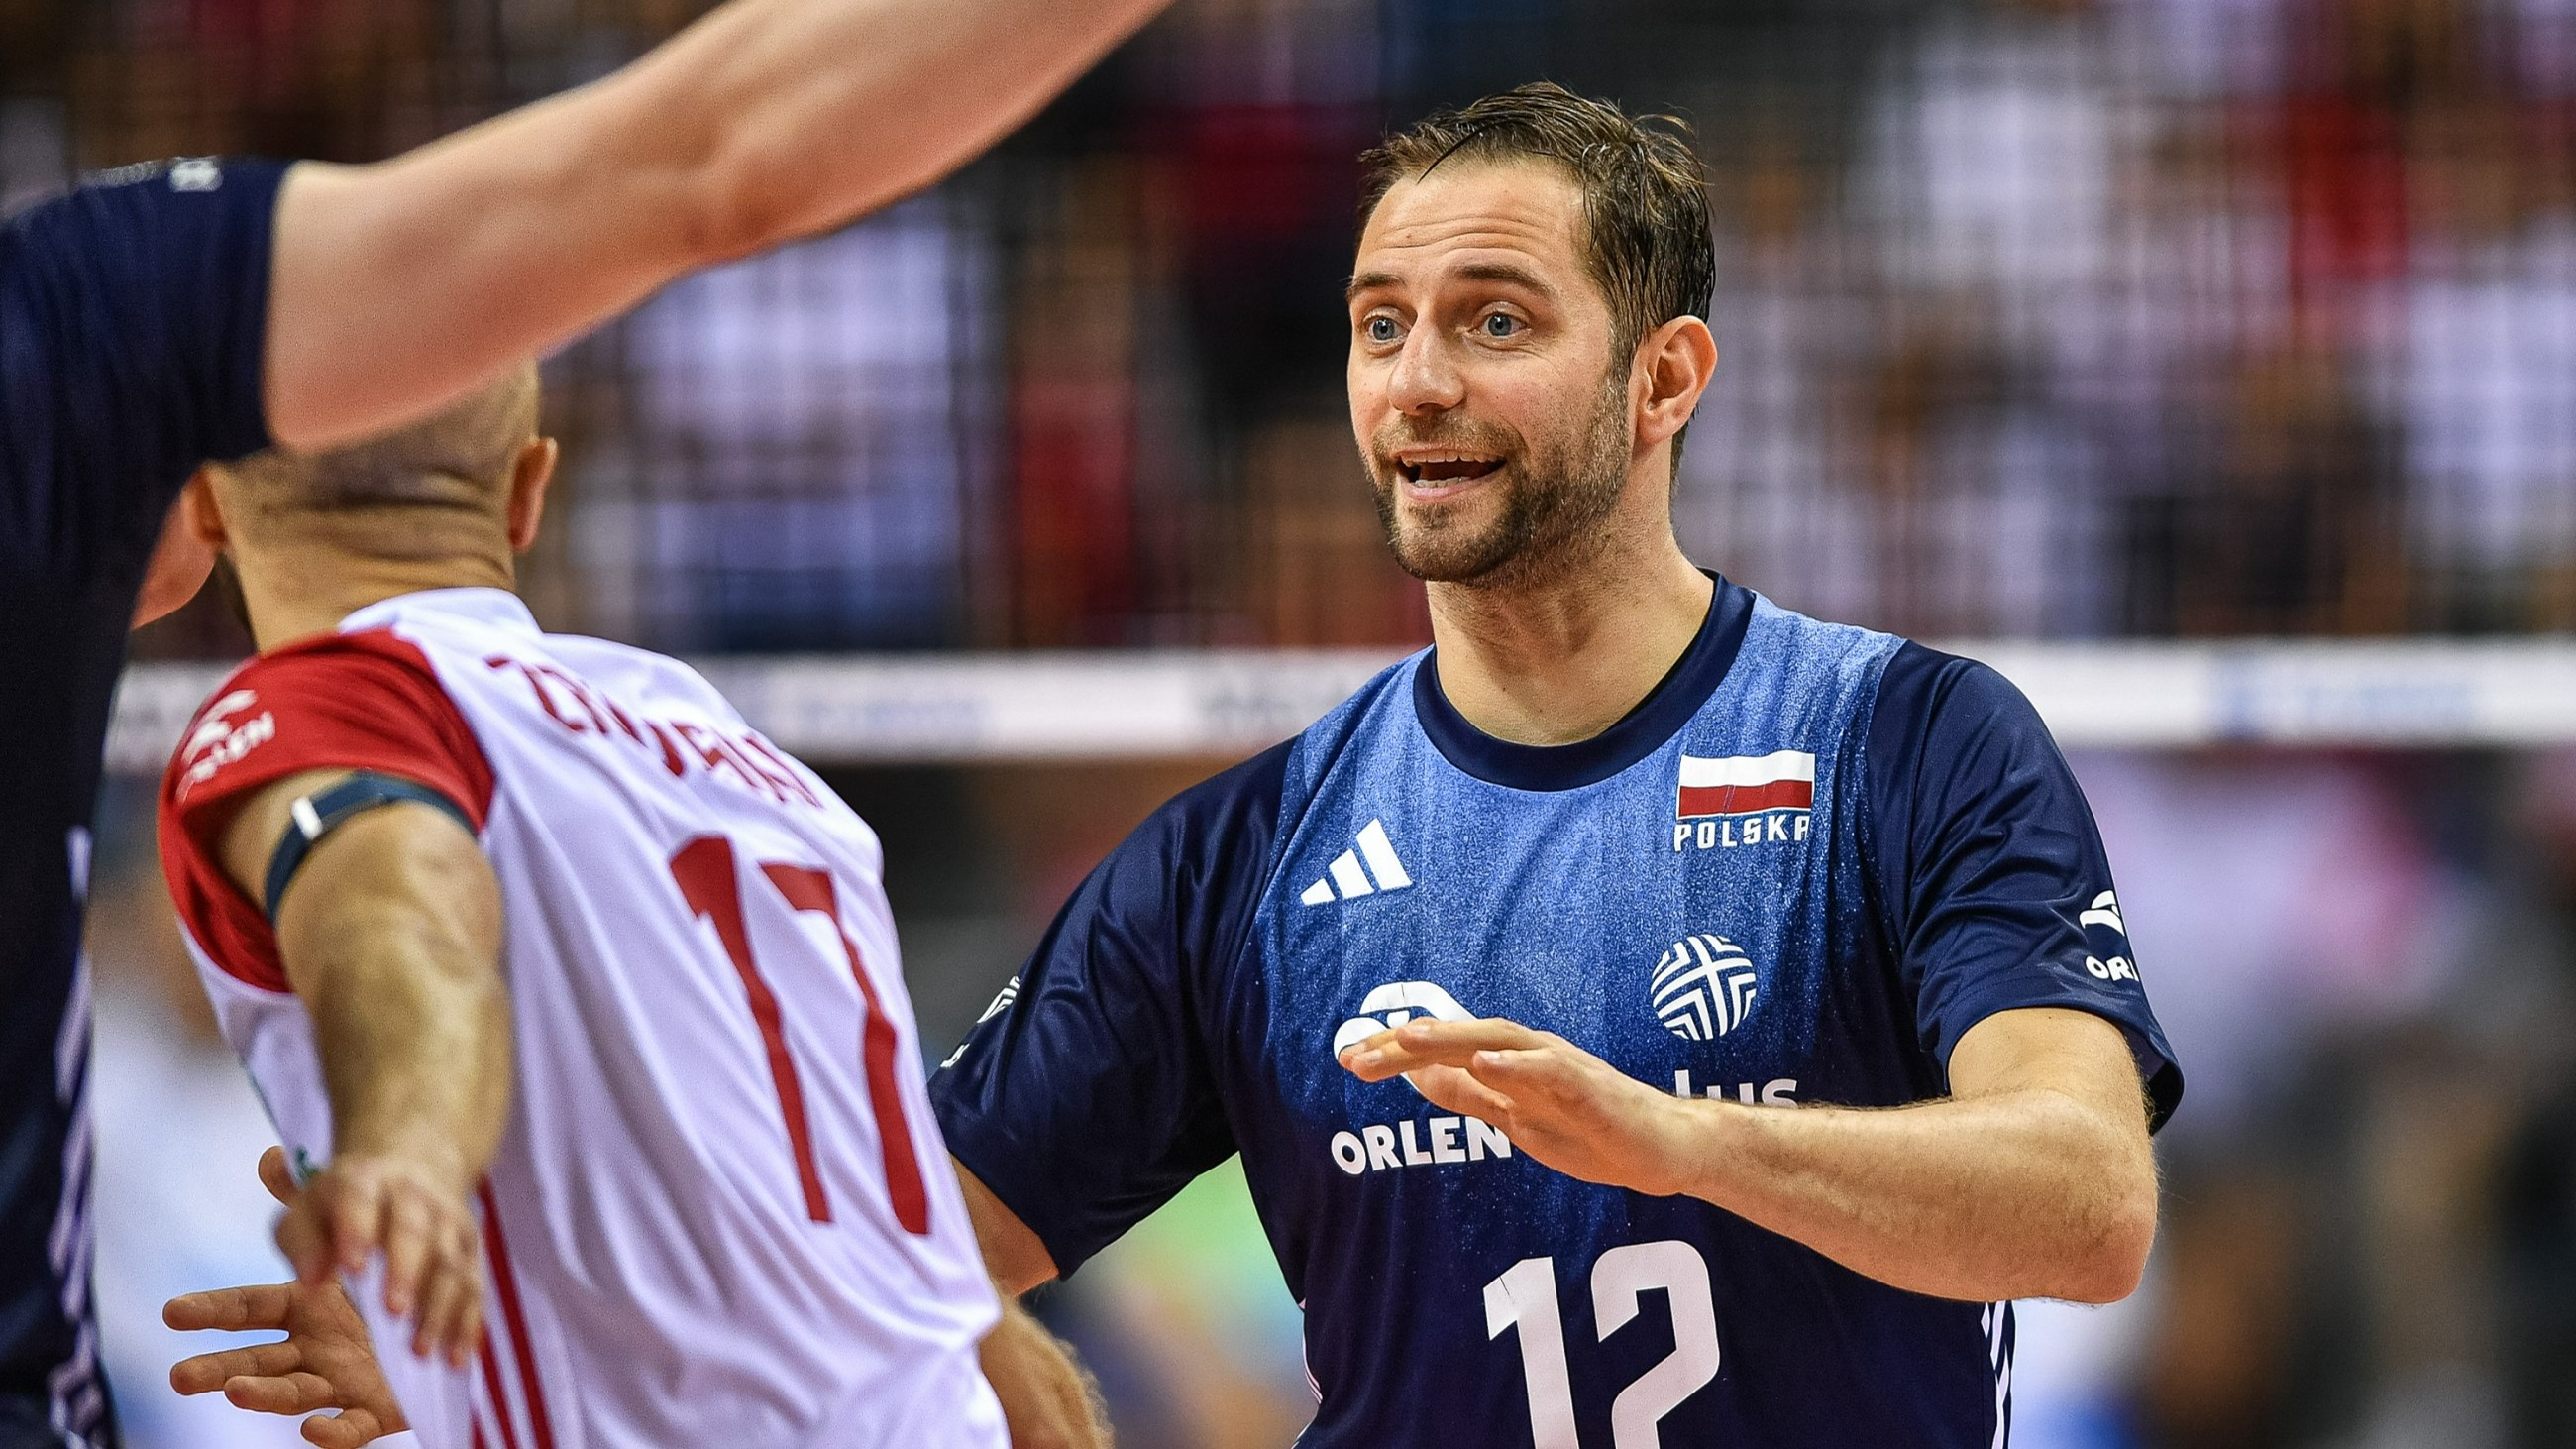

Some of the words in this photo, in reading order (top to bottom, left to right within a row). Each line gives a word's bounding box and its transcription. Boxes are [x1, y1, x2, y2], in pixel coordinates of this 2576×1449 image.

[1673, 814, 1811, 852] POLSKA
[2085, 955, 2140, 982] OR
[669, 836, 930, 1236] 17
[1331, 1116, 1512, 1175] ORLEN
[1483, 1239, 1721, 1449] 12
